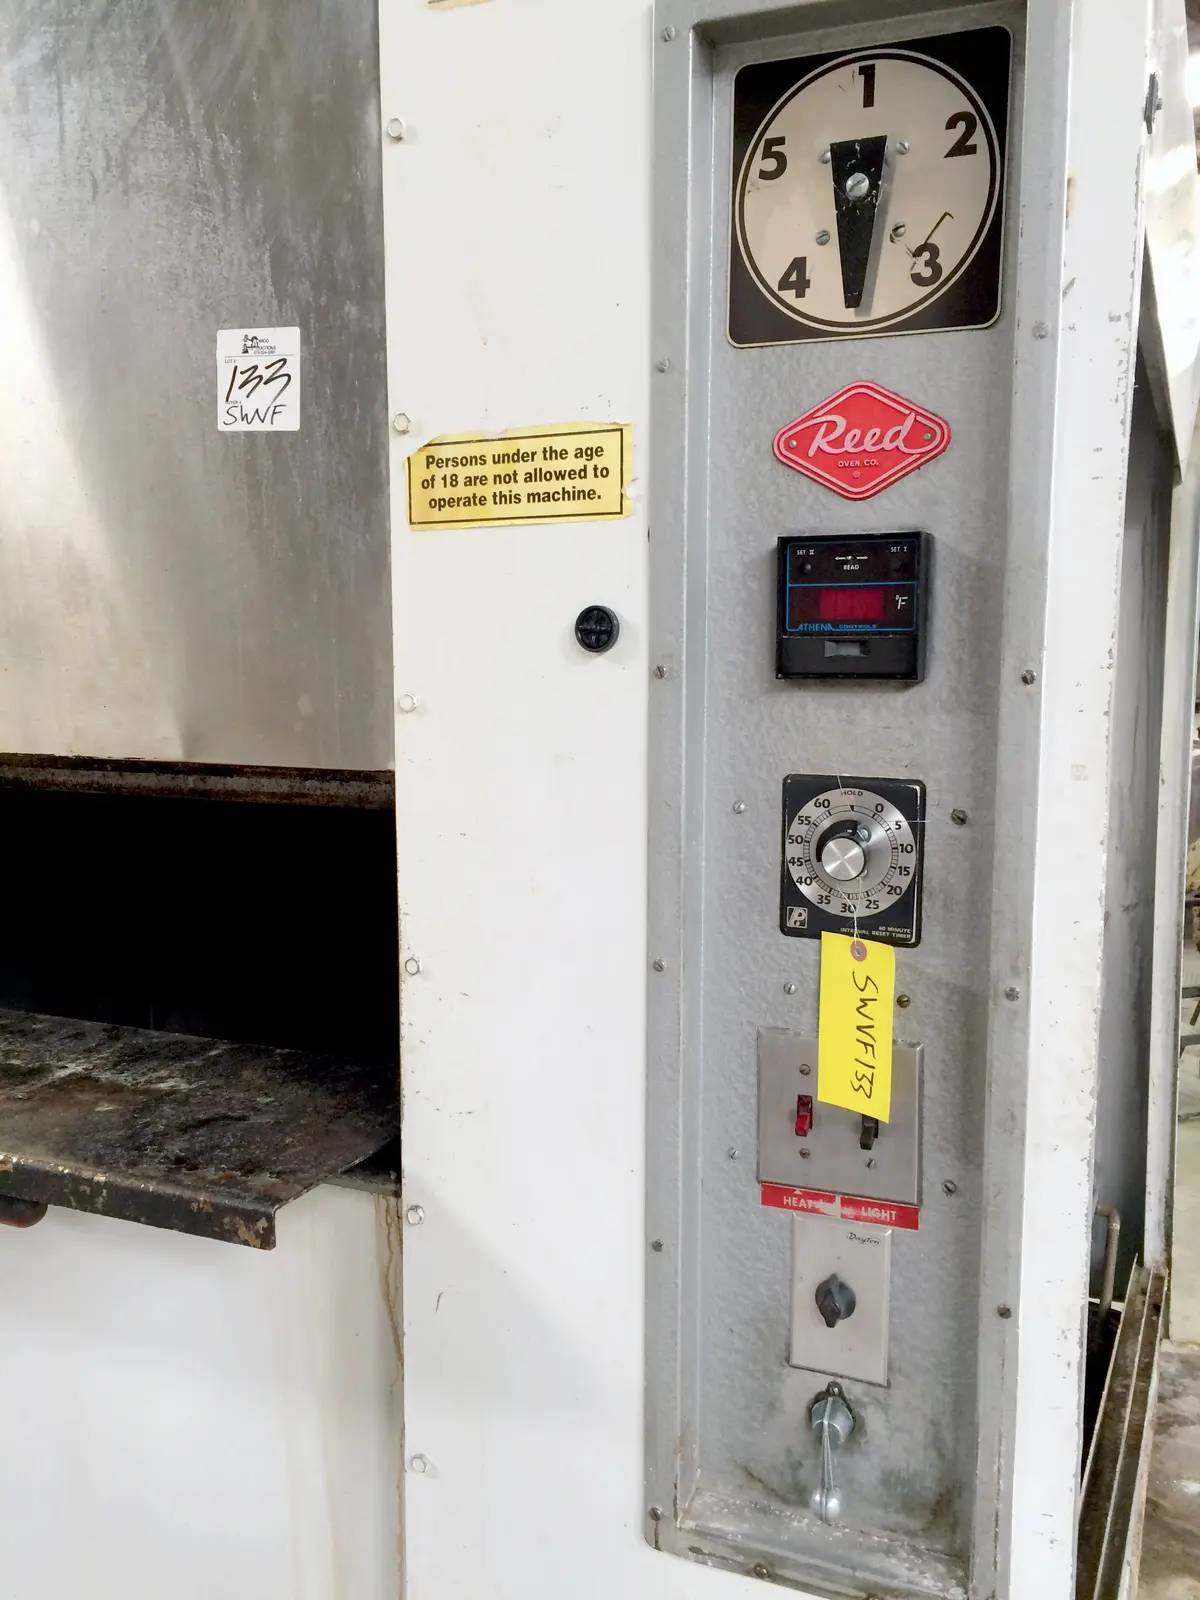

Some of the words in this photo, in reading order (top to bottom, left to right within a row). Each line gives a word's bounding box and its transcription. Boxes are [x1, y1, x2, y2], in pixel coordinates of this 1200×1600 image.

[858, 64, 876, 108] 1
[944, 111, 977, 158] 2
[758, 136, 787, 180] 5
[910, 242, 942, 286] 3
[778, 256, 810, 298] 4
[225, 358, 291, 405] 133
[808, 412, 917, 458] Reed
[425, 453, 487, 469] Persons
[492, 449, 537, 465] under
[542, 446, 568, 461] the
[574, 445, 604, 461] age
[838, 459, 860, 468] OVEN
[421, 475, 436, 489] of
[441, 474, 458, 488] 18
[463, 474, 488, 486] are
[493, 469, 518, 484] not
[523, 465, 587, 483] allowed
[593, 464, 609, 478] to
[429, 492, 487, 511] operate
[492, 490, 521, 505] this
[527, 486, 601, 503] machine.
[798, 623, 833, 631] ATHENA
[814, 798, 830, 808] 60
[875, 803, 884, 813] 0
[798, 815, 811, 825] 55
[895, 820, 902, 830] 5
[788, 834, 803, 844] 50
[900, 843, 913, 853] 10
[788, 856, 803, 866] 45
[898, 866, 910, 876] 15
[796, 876, 813, 886] 40
[886, 885, 902, 895] 20
[817, 894, 831, 904] 35
[865, 899, 880, 909] 25
[840, 903, 856, 913] 30
[861, 1206, 897, 1221] LIGHT
[848, 1232, 880, 1245] Dayton
